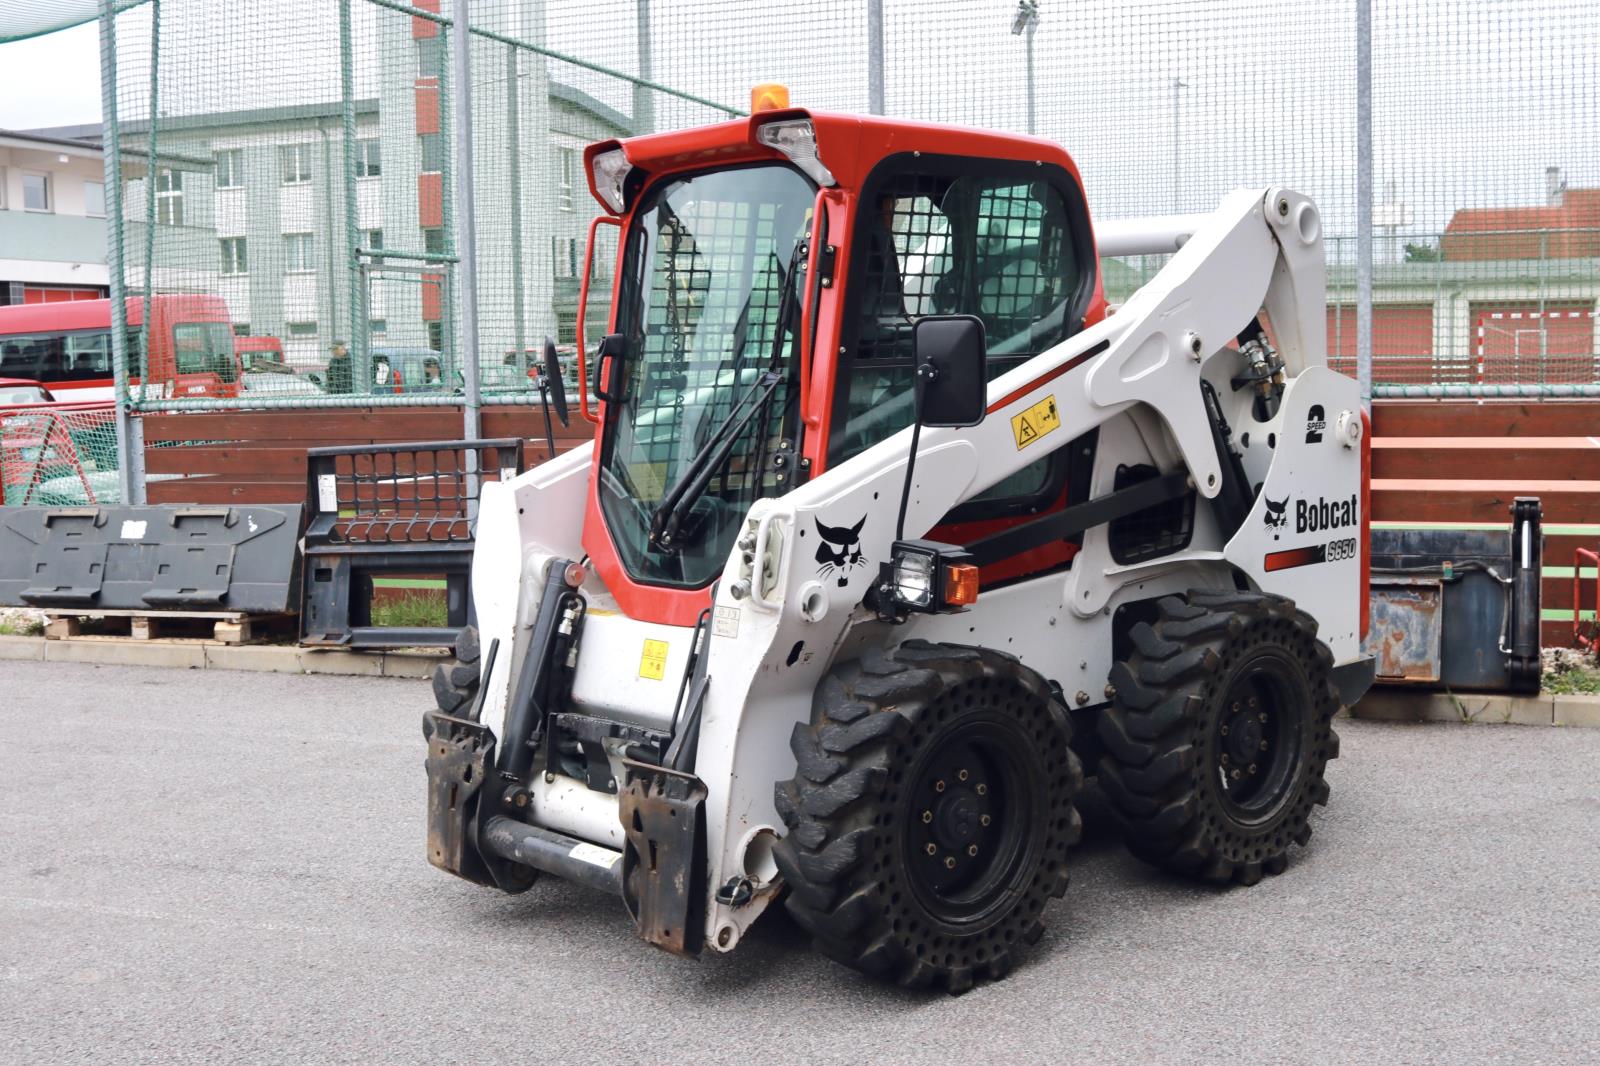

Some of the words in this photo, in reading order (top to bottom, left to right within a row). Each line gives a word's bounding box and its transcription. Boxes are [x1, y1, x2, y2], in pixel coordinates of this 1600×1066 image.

[1305, 404, 1325, 444] 2
[1306, 421, 1326, 430] SPEED
[1296, 494, 1357, 534] Bobcat
[1327, 538, 1357, 562] S650
